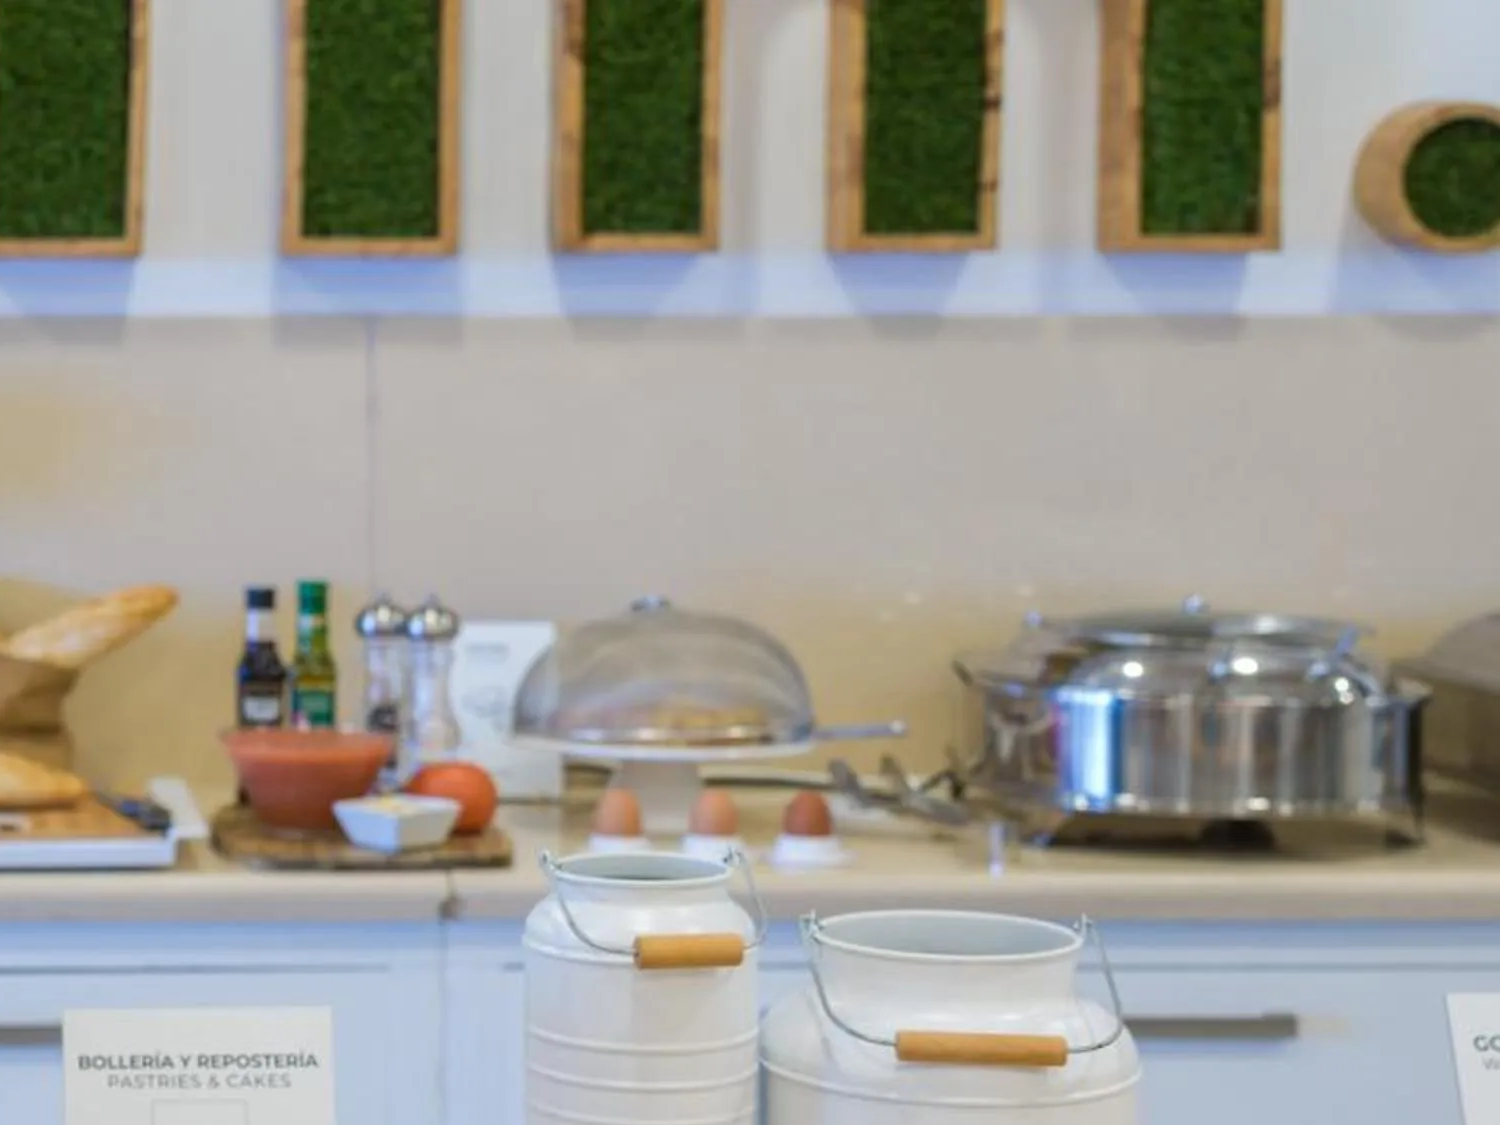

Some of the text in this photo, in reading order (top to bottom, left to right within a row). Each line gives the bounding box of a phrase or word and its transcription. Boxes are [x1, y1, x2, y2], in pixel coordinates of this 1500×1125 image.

[77, 1050, 319, 1070] BOLLERÍA Y REPOSTERÍA
[107, 1073, 292, 1089] PASTRIES & CAKES
